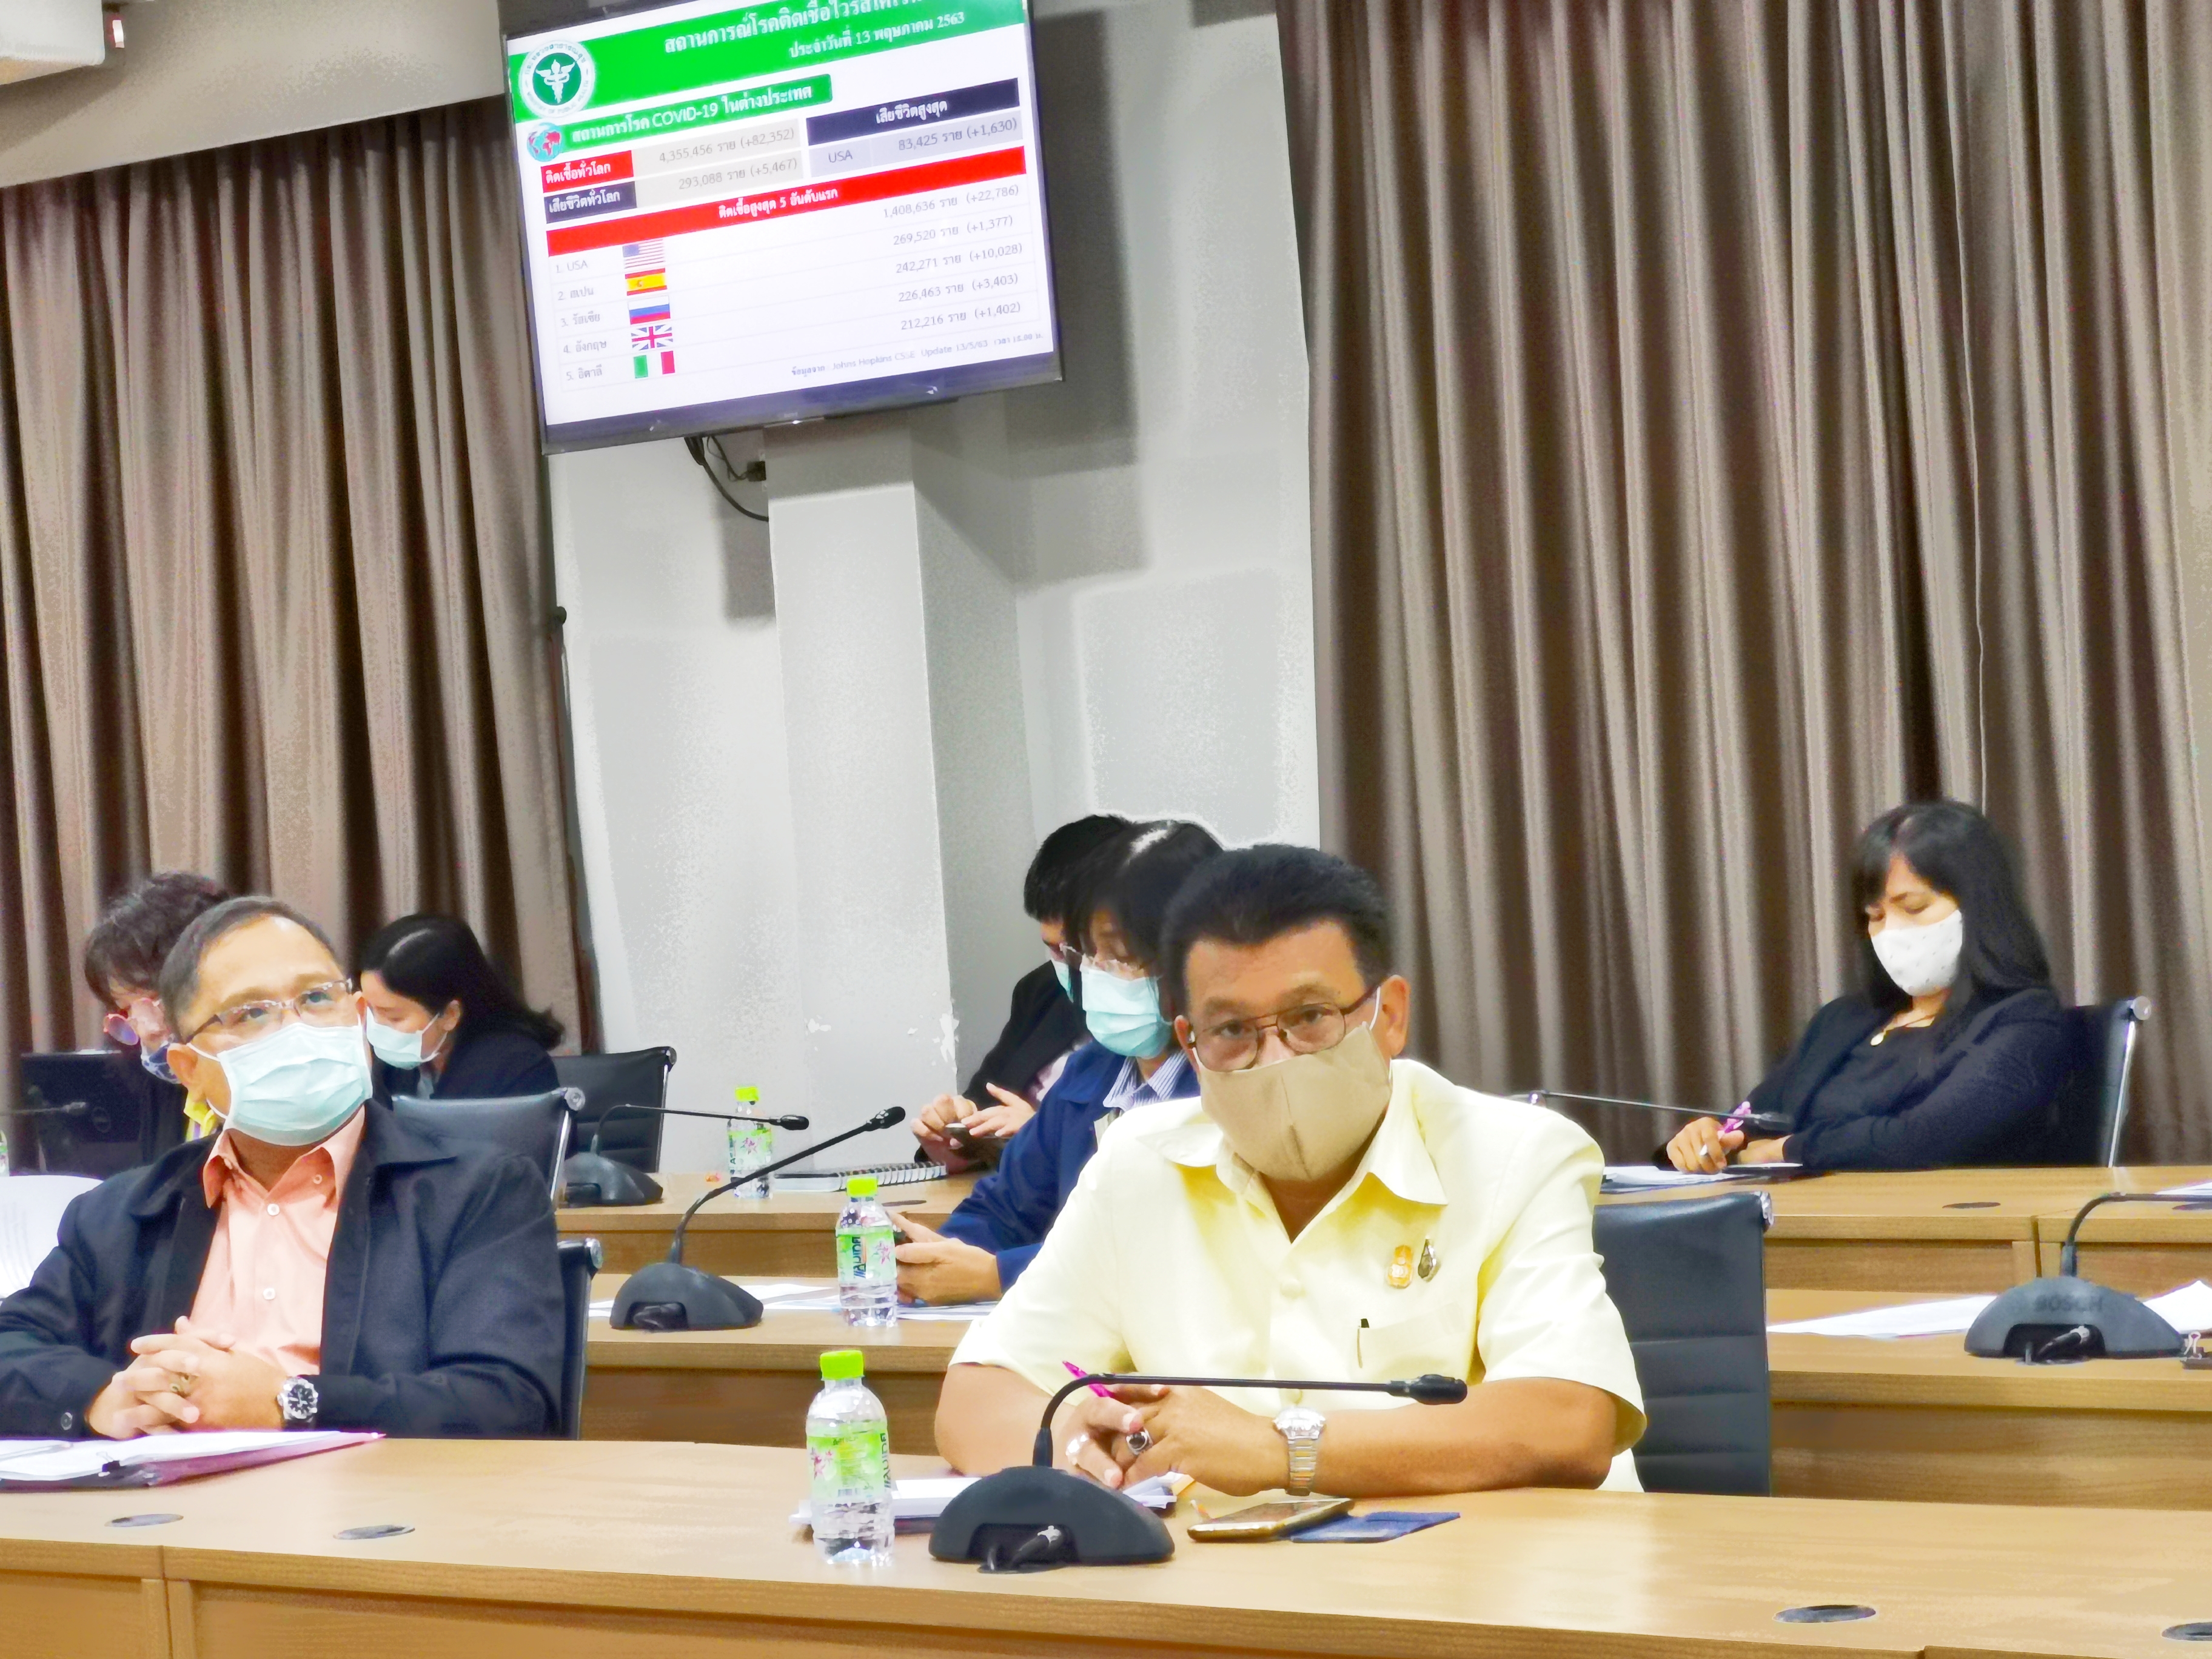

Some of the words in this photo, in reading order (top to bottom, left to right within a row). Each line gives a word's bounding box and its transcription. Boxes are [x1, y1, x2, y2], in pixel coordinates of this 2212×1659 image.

[856, 30, 871, 45] 13
[874, 18, 934, 42] พฤษภาคม
[937, 11, 965, 28] 2563
[652, 102, 719, 128] COVID-19
[723, 85, 812, 114] ในต่างประเทศ
[876, 100, 948, 124] เสียชีวิตสูงสุด
[546, 160, 611, 184] ติดเชื้อทั่วโลก
[659, 144, 712, 163] 4,355,456
[717, 140, 736, 152] ราย
[740, 127, 794, 149] (+82,352)
[828, 149, 853, 164] USA
[942, 130, 962, 142] ราย
[967, 117, 1017, 139] (+1,630)
[549, 189, 621, 213] เสียชีวิตทั่วโลก
[679, 172, 723, 190] 293,088
[727, 169, 746, 181] ราย
[750, 158, 797, 178] (+5,467)
[967, 184, 1019, 204] (+22,786)
[780, 196, 787, 209] 5
[893, 229, 936, 246] 269,520
[967, 215, 1013, 233] (+1,377)
[567, 260, 588, 272] USA
[896, 258, 938, 274] 242,271
[970, 243, 1022, 263] (+10,028)
[898, 286, 941, 303] 226,463
[972, 273, 1018, 291] (+3,403)
[901, 314, 943, 331] 212,216
[974, 301, 1021, 320] (+1,402)
[575, 339, 607, 353] อังกฤษ
[921, 346, 952, 357] Update
